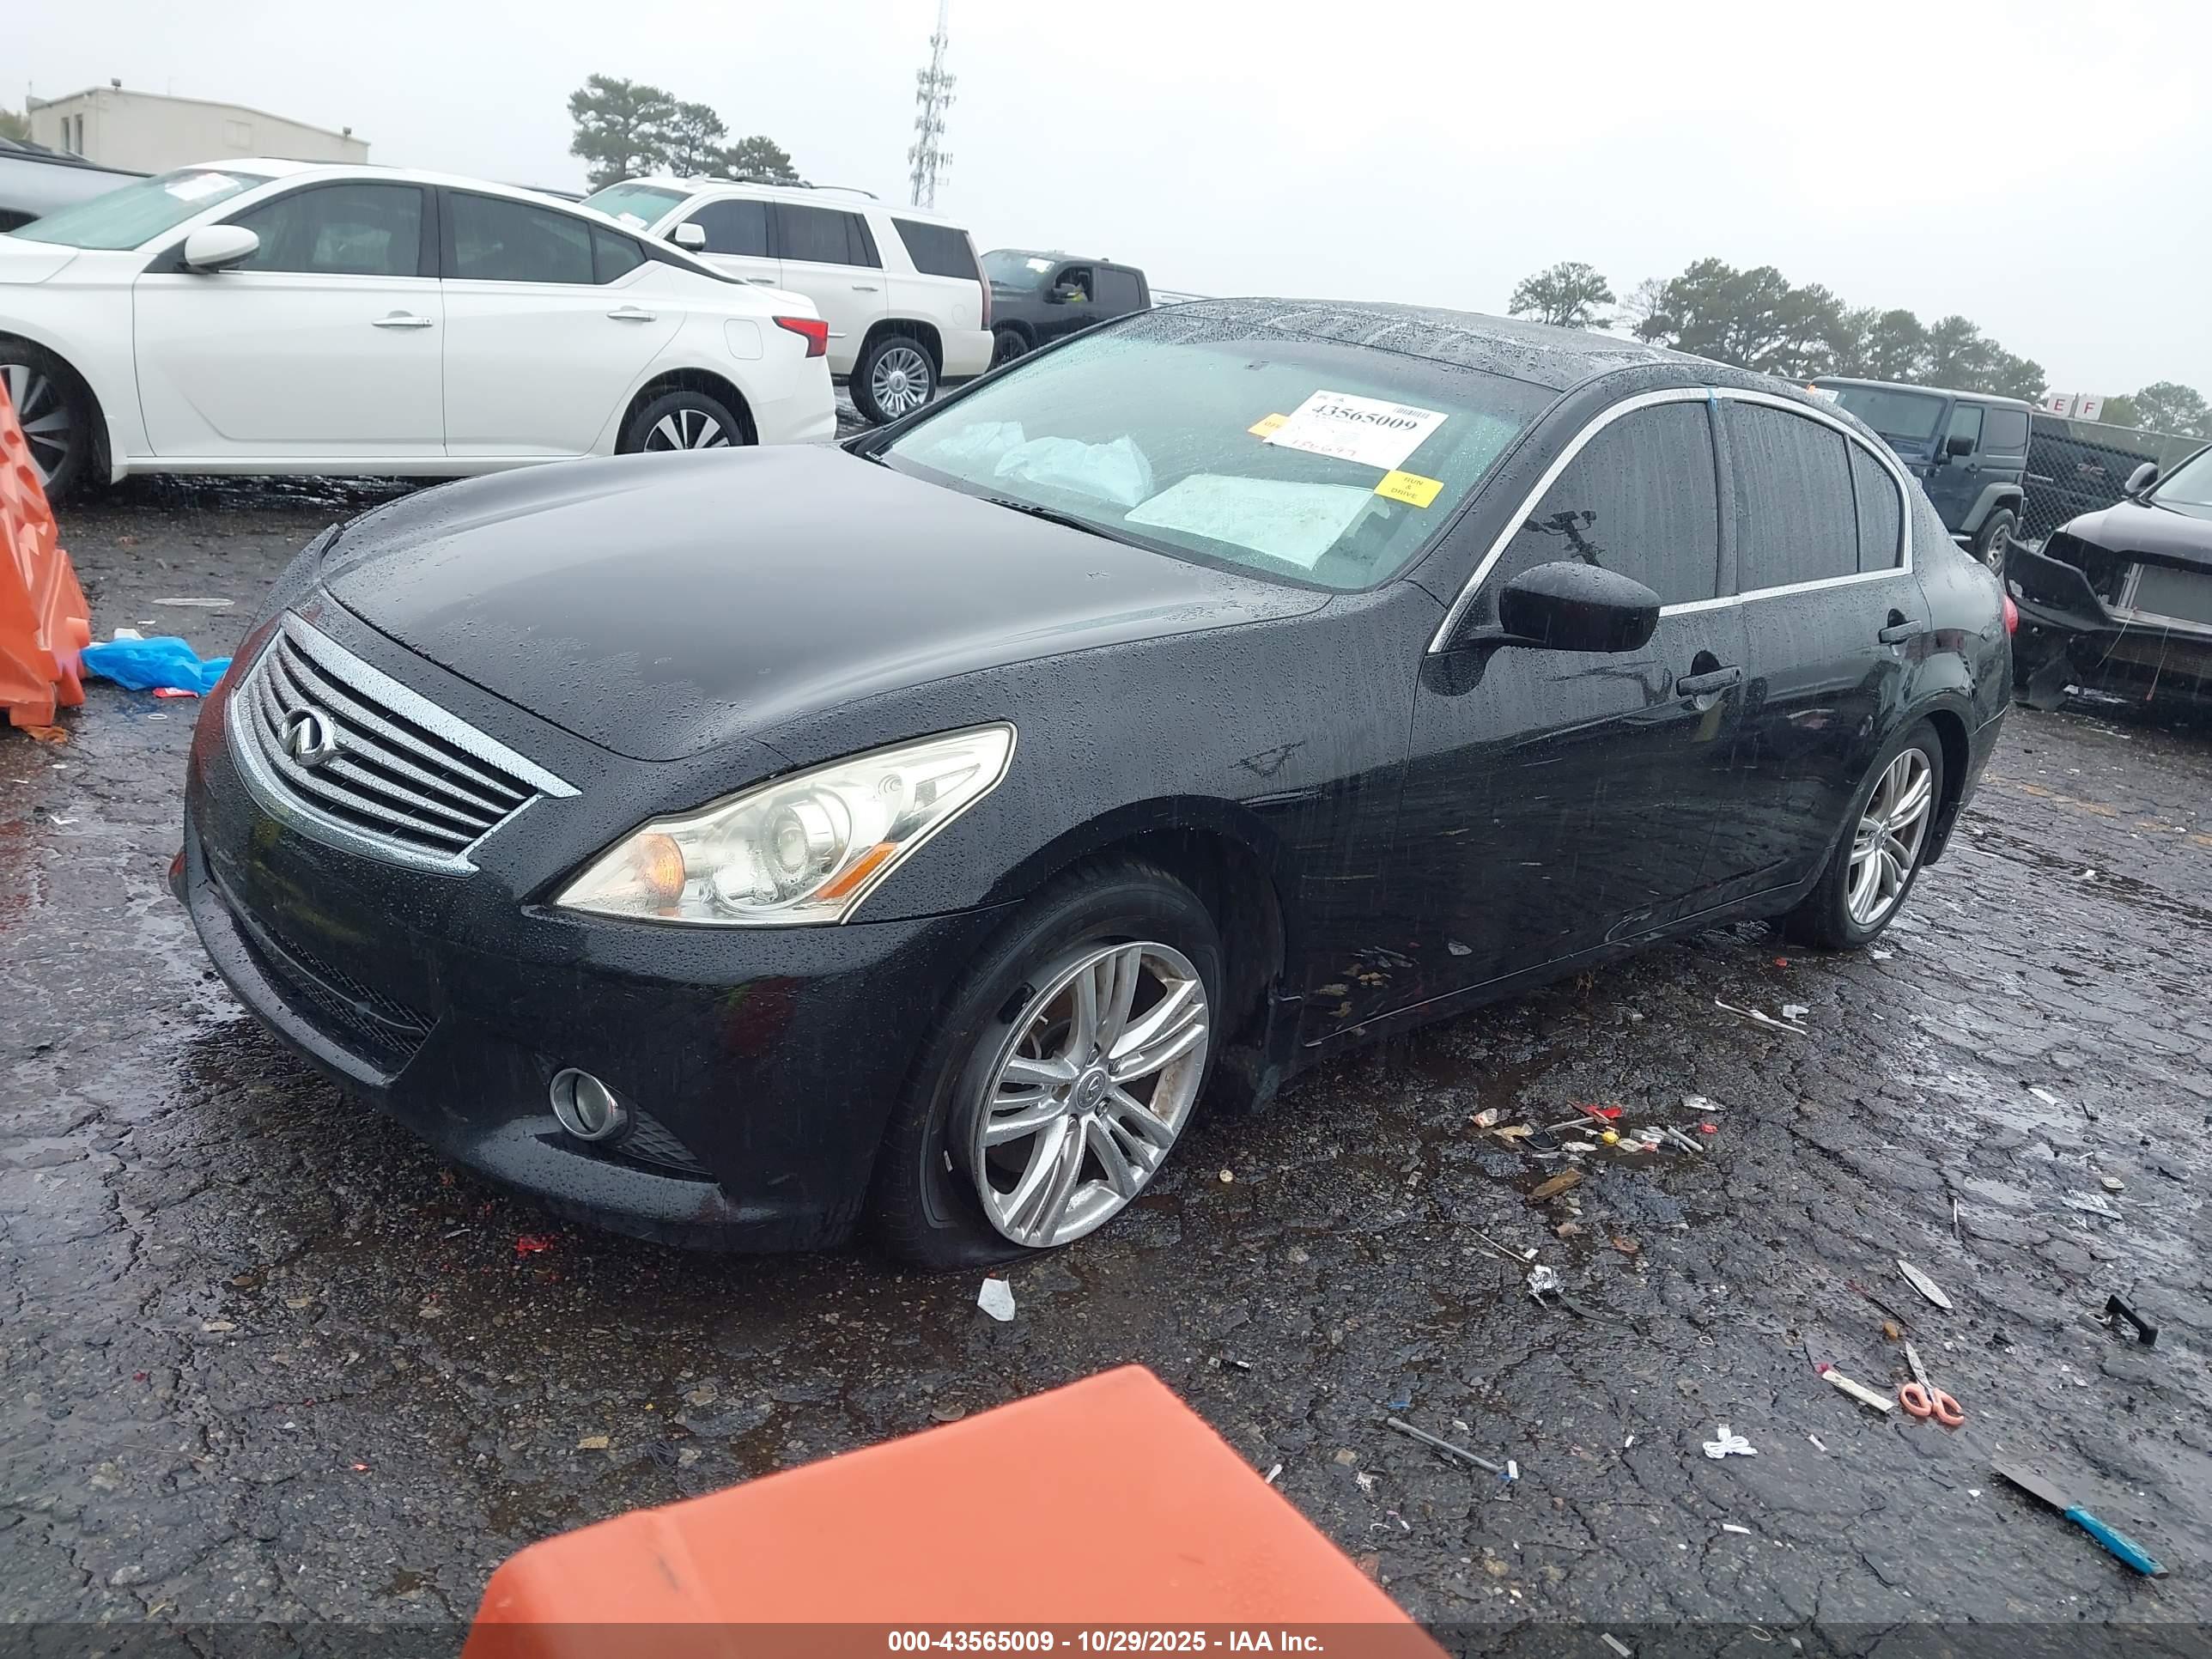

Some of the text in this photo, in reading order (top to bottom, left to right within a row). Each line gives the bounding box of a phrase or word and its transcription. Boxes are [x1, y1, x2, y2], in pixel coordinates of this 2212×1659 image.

[2054, 398, 2065, 410] E
[2084, 402, 2095, 414] F
[1311, 404, 1418, 432] 43565009
[1404, 476, 1424, 485] RUN
[1391, 488, 1418, 499] DRIVE
